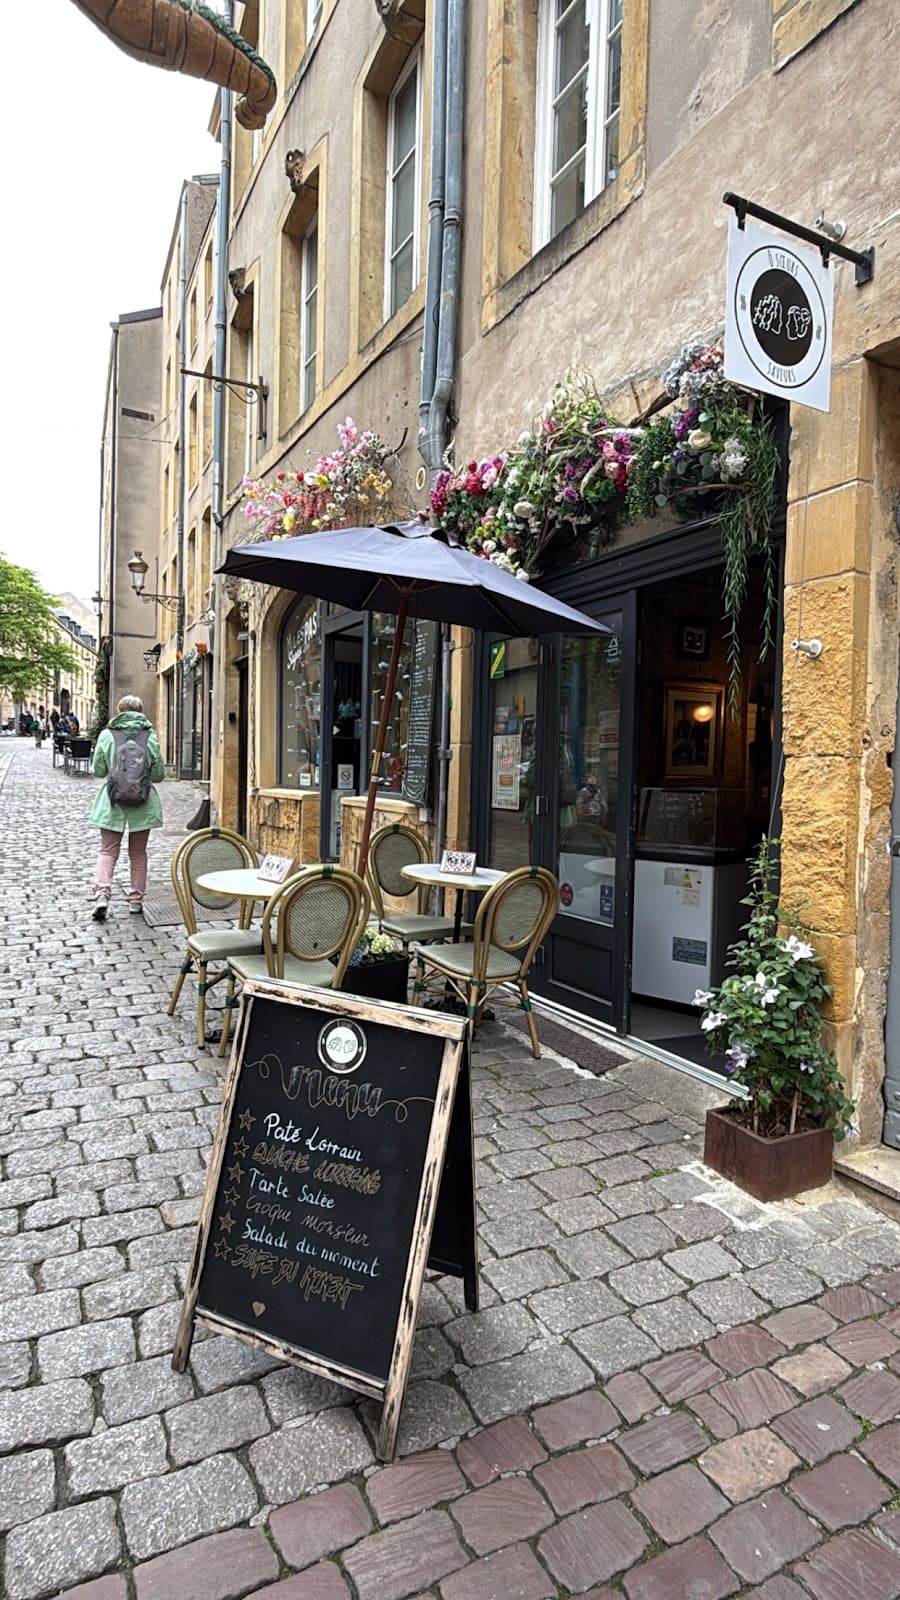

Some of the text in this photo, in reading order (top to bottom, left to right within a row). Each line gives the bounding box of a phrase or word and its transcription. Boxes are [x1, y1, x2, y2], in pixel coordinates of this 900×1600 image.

[767, 361, 797, 383] SAVEURS
[305, 1126, 363, 1162] Lorrain
[246, 1195, 292, 1226] Croque
[298, 1184, 336, 1209] Salée
[296, 1237, 317, 1256] du
[320, 1248, 380, 1277] moment
[272, 1258, 299, 1285] DU
[301, 1265, 364, 1310] MOMENT
